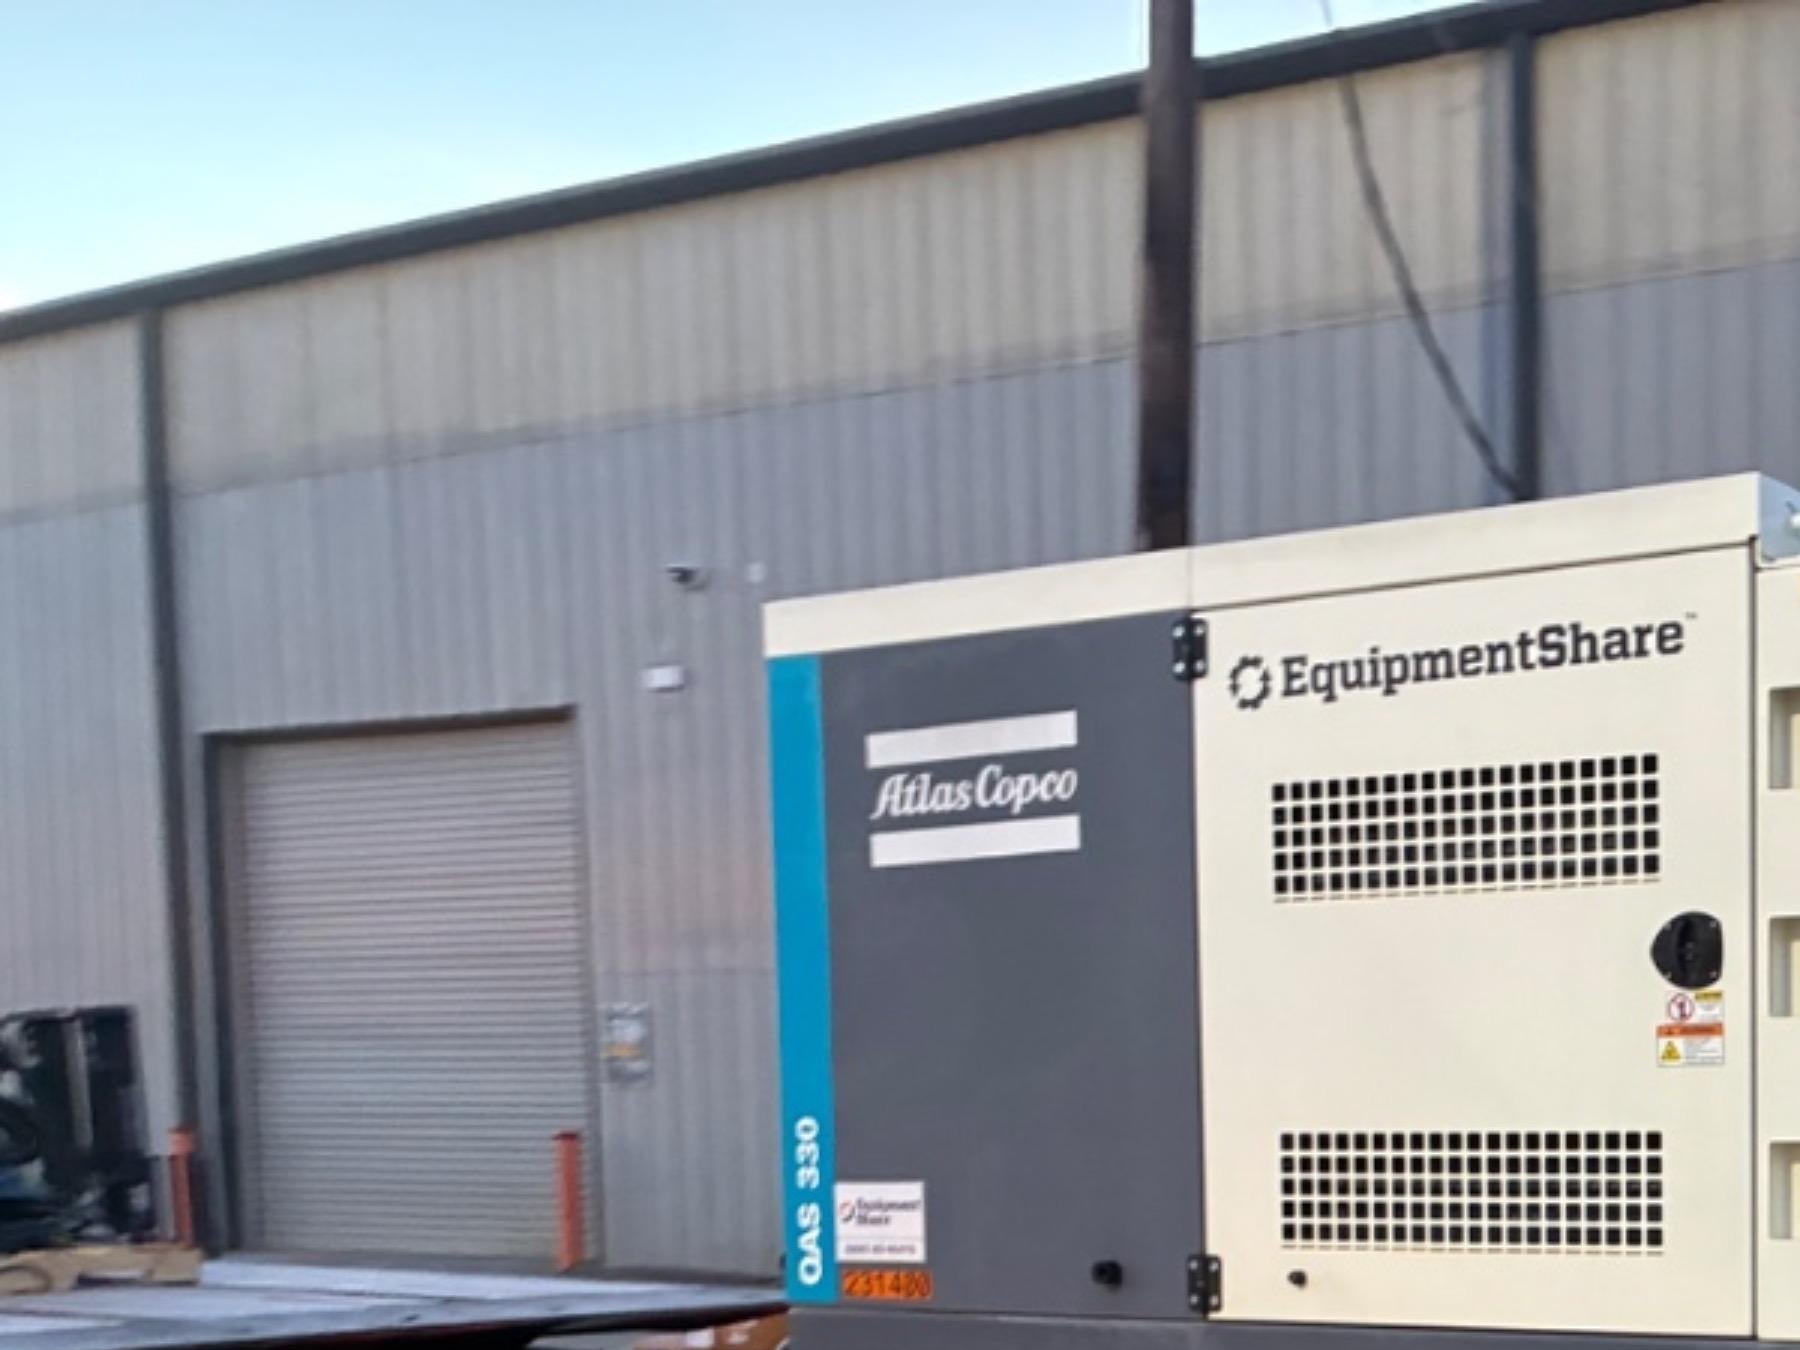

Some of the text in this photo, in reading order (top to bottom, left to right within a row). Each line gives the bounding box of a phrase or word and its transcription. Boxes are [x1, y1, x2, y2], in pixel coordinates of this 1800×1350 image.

[1280, 620, 1685, 703] EquipmentShare
[869, 763, 1079, 820] Atlas Copco
[794, 1115, 824, 1286] QAS 330
